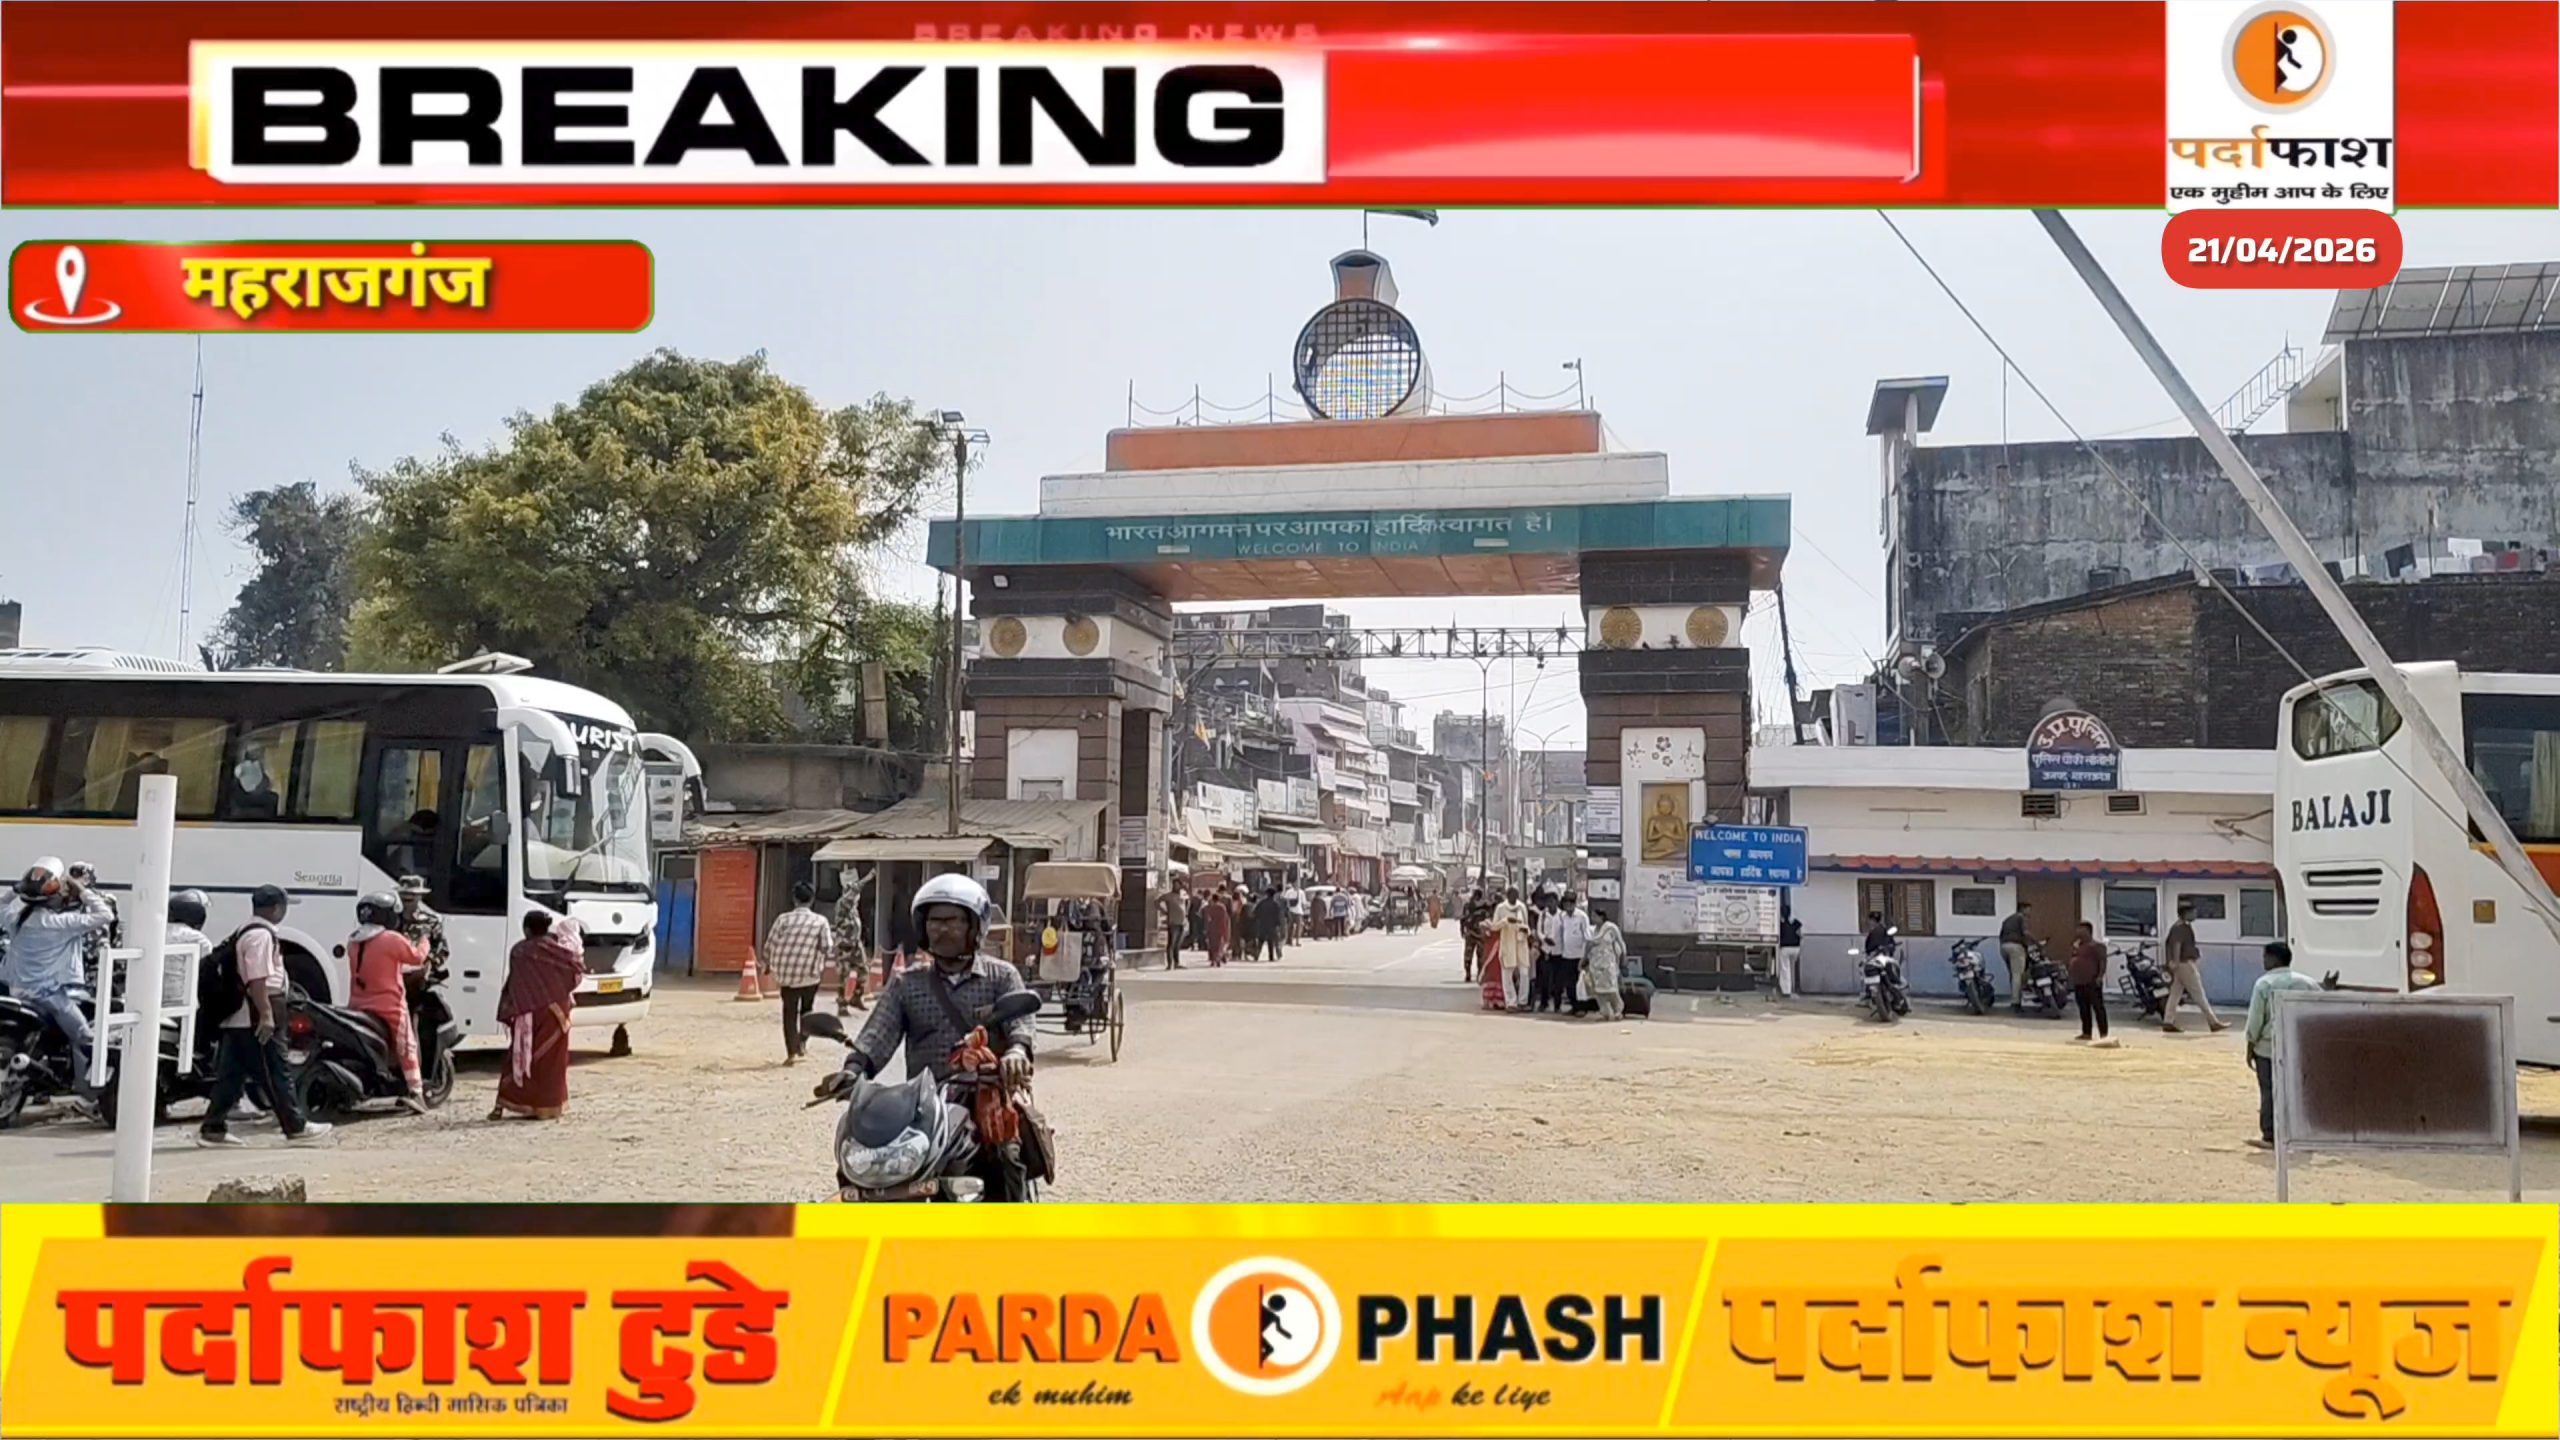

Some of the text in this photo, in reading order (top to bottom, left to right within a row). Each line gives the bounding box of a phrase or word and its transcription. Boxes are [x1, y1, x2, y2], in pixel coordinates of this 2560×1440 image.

[1105, 525, 1165, 540] भारत
[1167, 523, 1252, 538] आगमन
[1255, 521, 1287, 536] पर
[1289, 519, 1370, 535] आपका
[1238, 542, 1322, 555] WELCOME
[1372, 541, 1419, 553] NDIA
[2292, 789, 2391, 832] BALAJI
[1695, 829, 1802, 844] WELCOME TO INDIA
